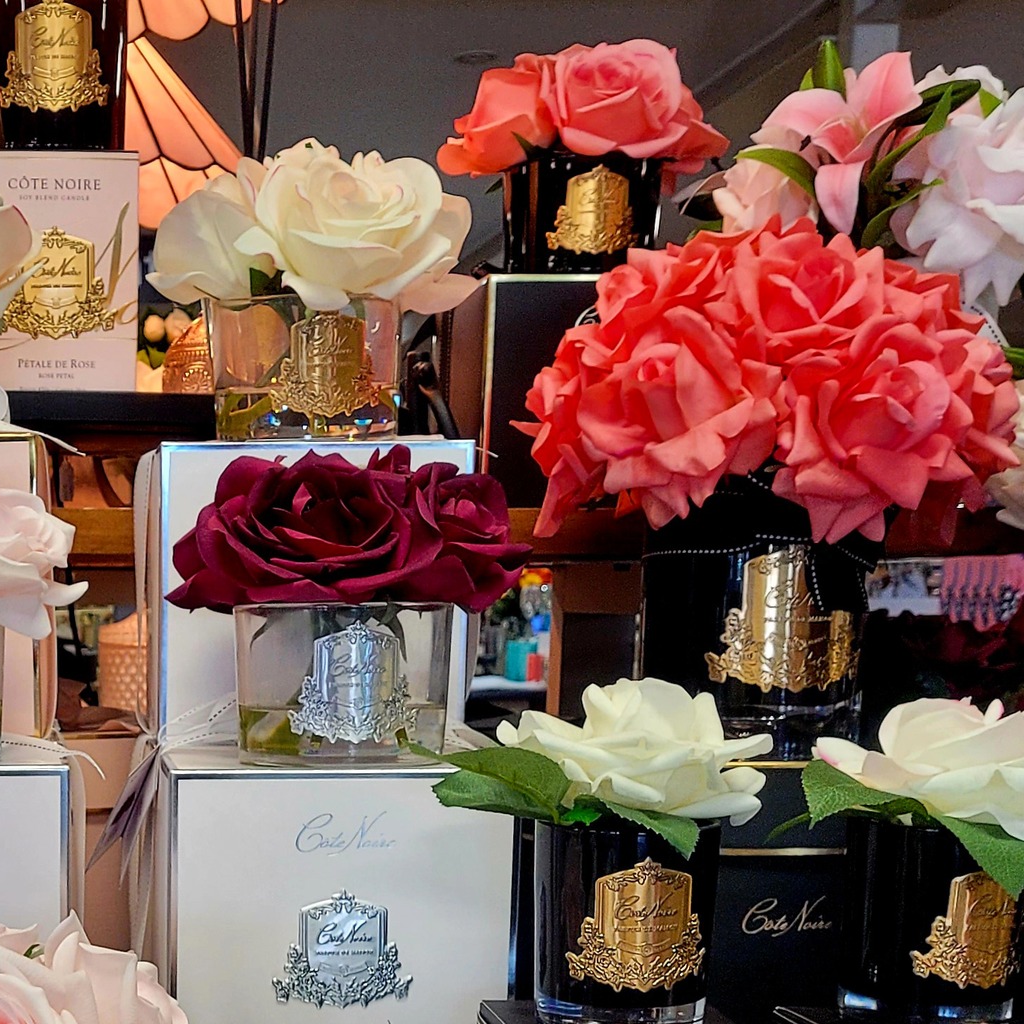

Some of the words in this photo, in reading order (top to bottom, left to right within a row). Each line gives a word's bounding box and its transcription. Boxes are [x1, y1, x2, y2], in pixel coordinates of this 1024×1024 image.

[8, 175, 49, 190] CÔTE
[54, 178, 101, 190] NOIRE
[55, 360, 67, 369] DE
[70, 359, 96, 369] ROSE
[336, 811, 396, 855] Noire
[779, 895, 832, 936] Noire
